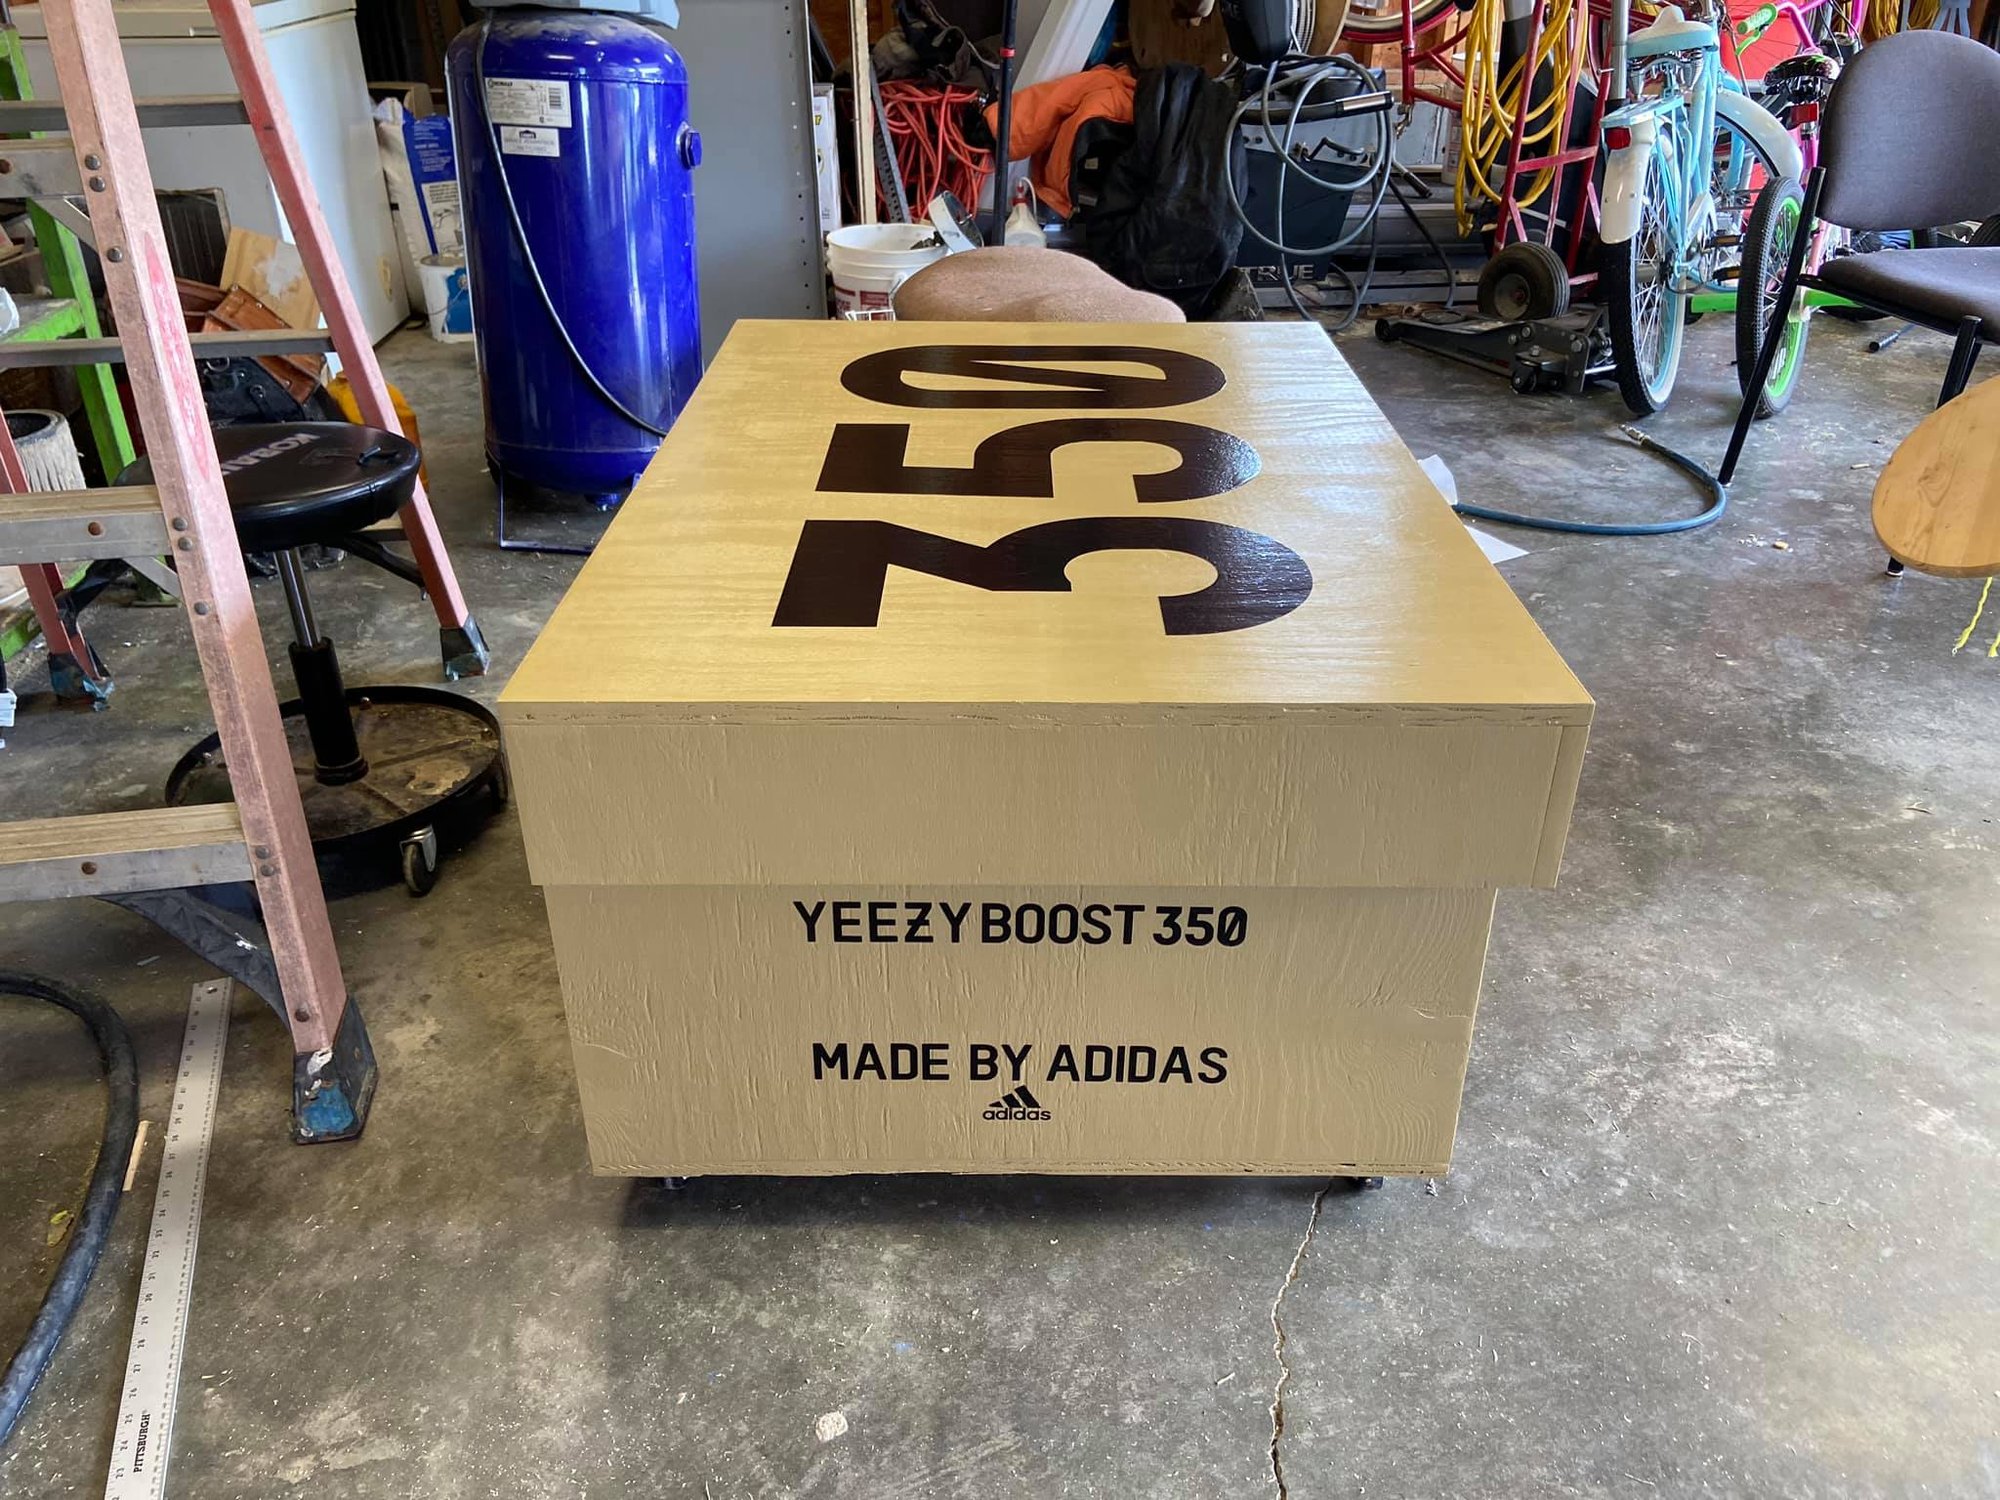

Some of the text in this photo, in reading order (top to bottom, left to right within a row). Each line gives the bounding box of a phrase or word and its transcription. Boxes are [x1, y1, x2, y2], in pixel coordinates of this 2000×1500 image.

[771, 345, 1314, 636] 350
[793, 901, 1248, 947] YEEZY BOOST 350
[812, 1043, 1229, 1084] MADE BY ADIDAS
[982, 1107, 1052, 1121] adidas
[144, 1293, 153, 1302] 30
[137, 1339, 145, 1349] 28
[133, 1364, 141, 1373] 27
[129, 1388, 138, 1398] 26
[125, 1413, 133, 1424] 25
[120, 1440, 129, 1451] 24
[133, 1413, 151, 1473] PITTSBURGH
[116, 1467, 125, 1479] 23
